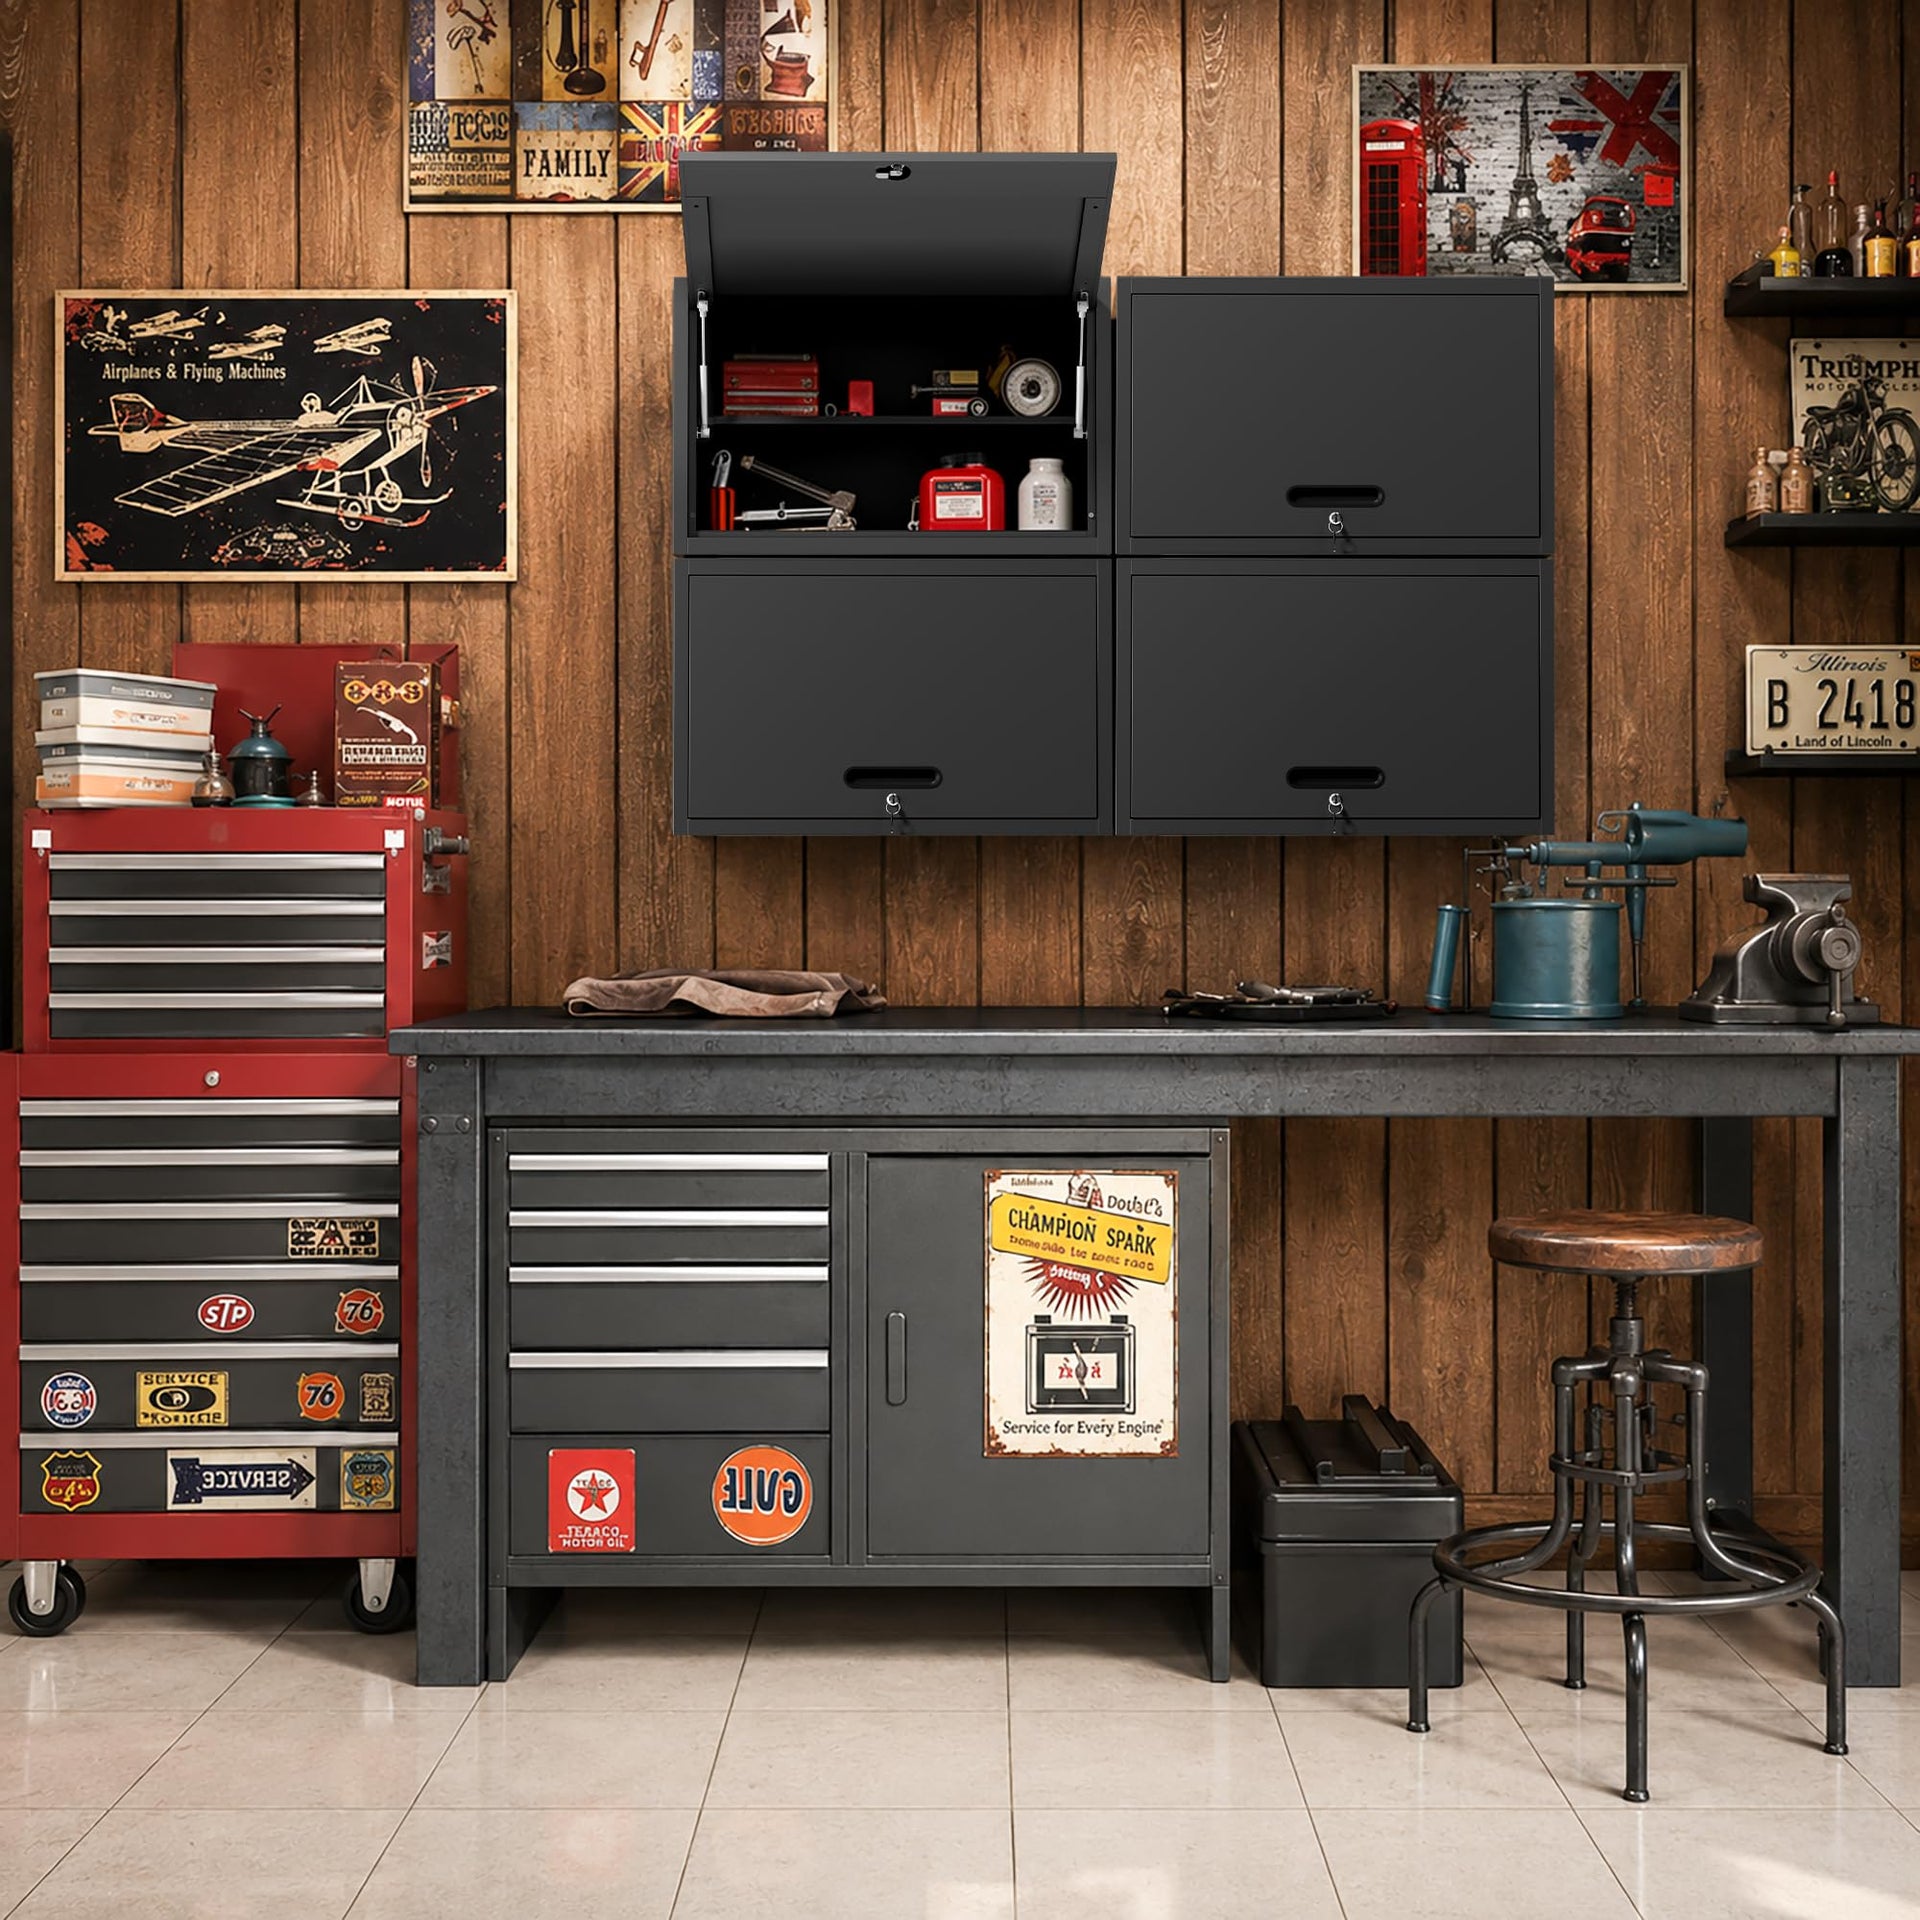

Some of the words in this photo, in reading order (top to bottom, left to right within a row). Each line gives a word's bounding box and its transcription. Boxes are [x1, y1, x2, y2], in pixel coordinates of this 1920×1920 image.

[523, 149, 611, 178] FAMILY
[102, 363, 161, 382] Airplanes
[166, 363, 178, 379] &
[184, 363, 223, 382] Flying
[228, 362, 286, 379] Machines
[1799, 355, 1920, 382] TRIUMPH
[1794, 652, 1888, 673] Illinois
[1767, 679, 1789, 729] B
[1817, 678, 1916, 729] 2418
[1795, 735, 1827, 747] Land
[1830, 735, 1843, 747] of
[1847, 735, 1892, 747] Lincoln
[1008, 1207, 1097, 1243] CHAMPION
[1107, 1227, 1157, 1256] SPARK
[204, 1298, 247, 1329] STP
[345, 1298, 374, 1323] 76
[306, 1382, 337, 1408] 76
[1002, 1420, 1050, 1434] Service
[1054, 1420, 1073, 1434] for
[1077, 1420, 1114, 1437] Every
[1118, 1420, 1162, 1437] Engine
